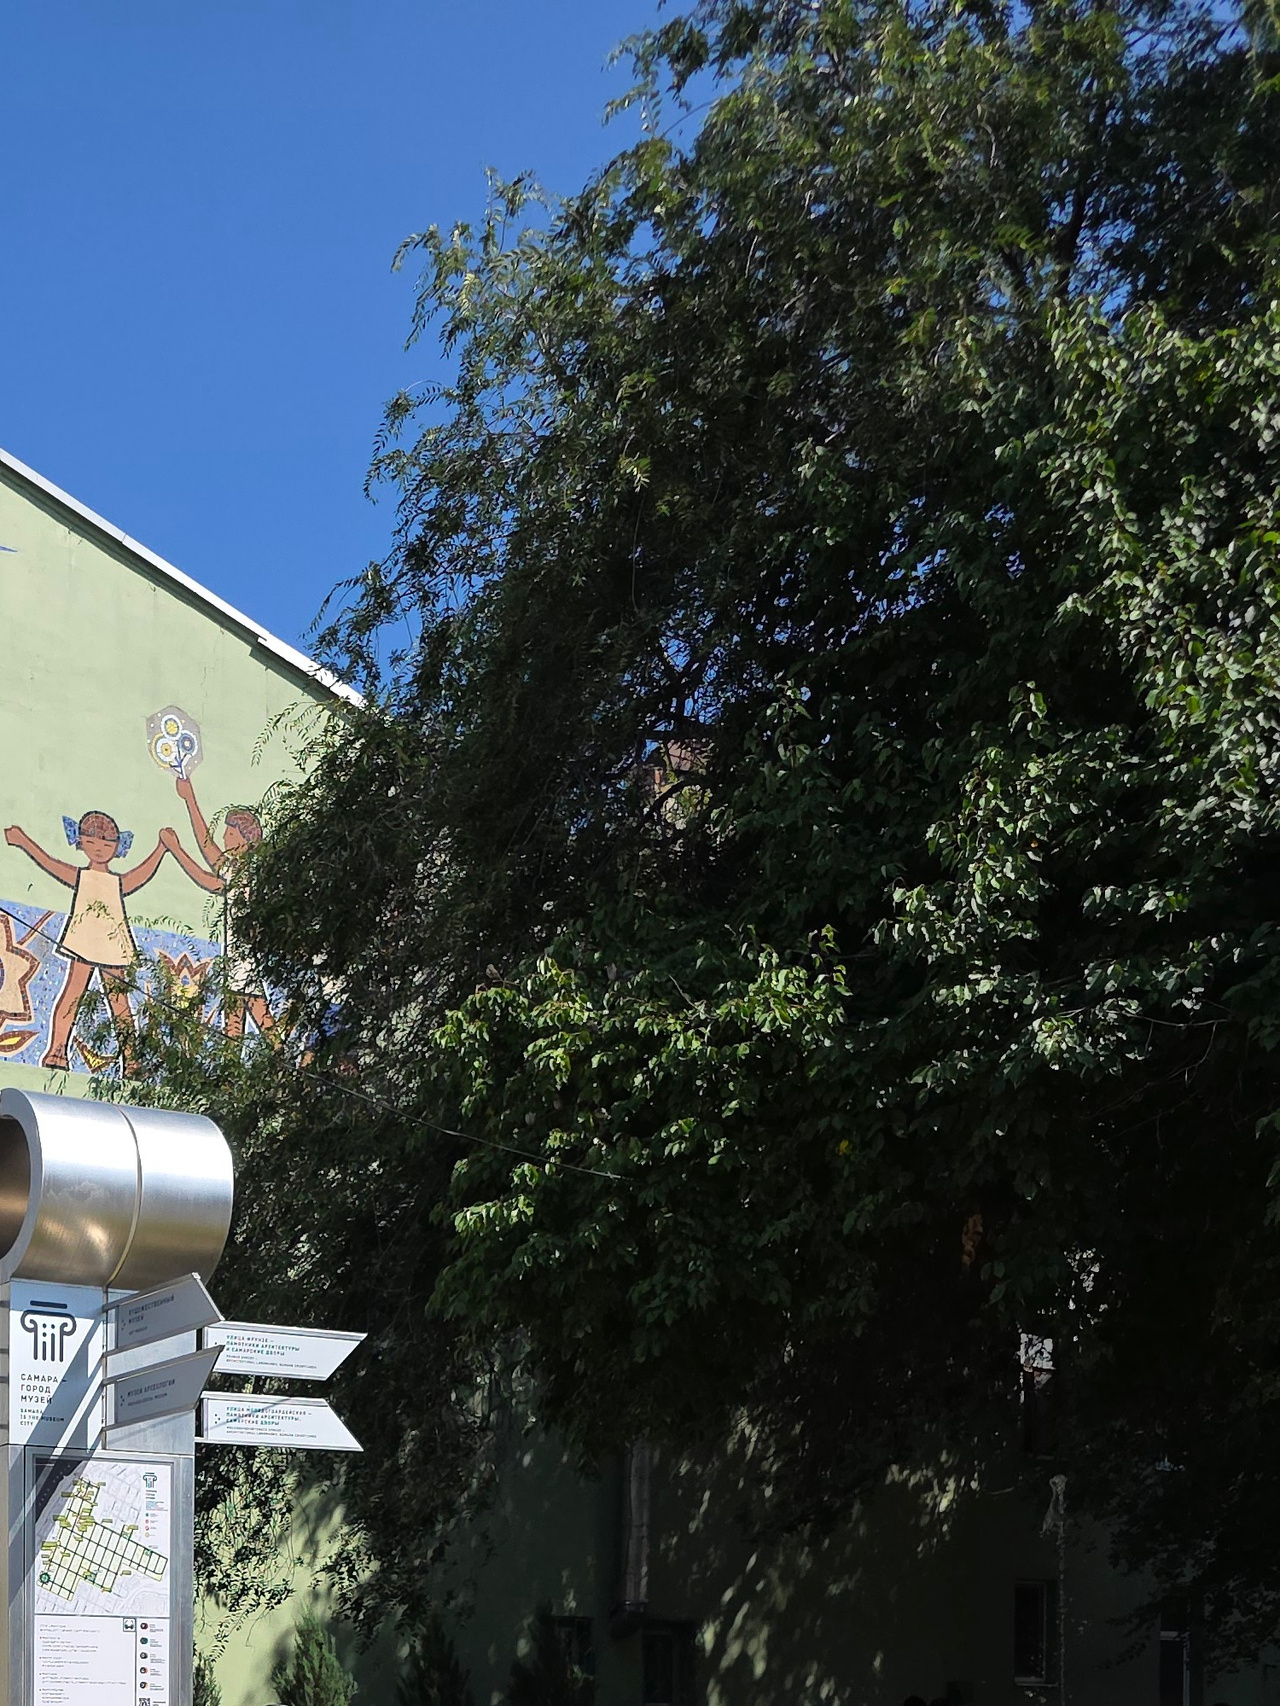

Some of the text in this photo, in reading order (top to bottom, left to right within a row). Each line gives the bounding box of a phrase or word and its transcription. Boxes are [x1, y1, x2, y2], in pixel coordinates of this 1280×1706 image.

[21, 1373, 58, 1383] САМАРА
[21, 1384, 51, 1393] ГОРОД
[21, 1395, 52, 1404] МУЗЕЙ
